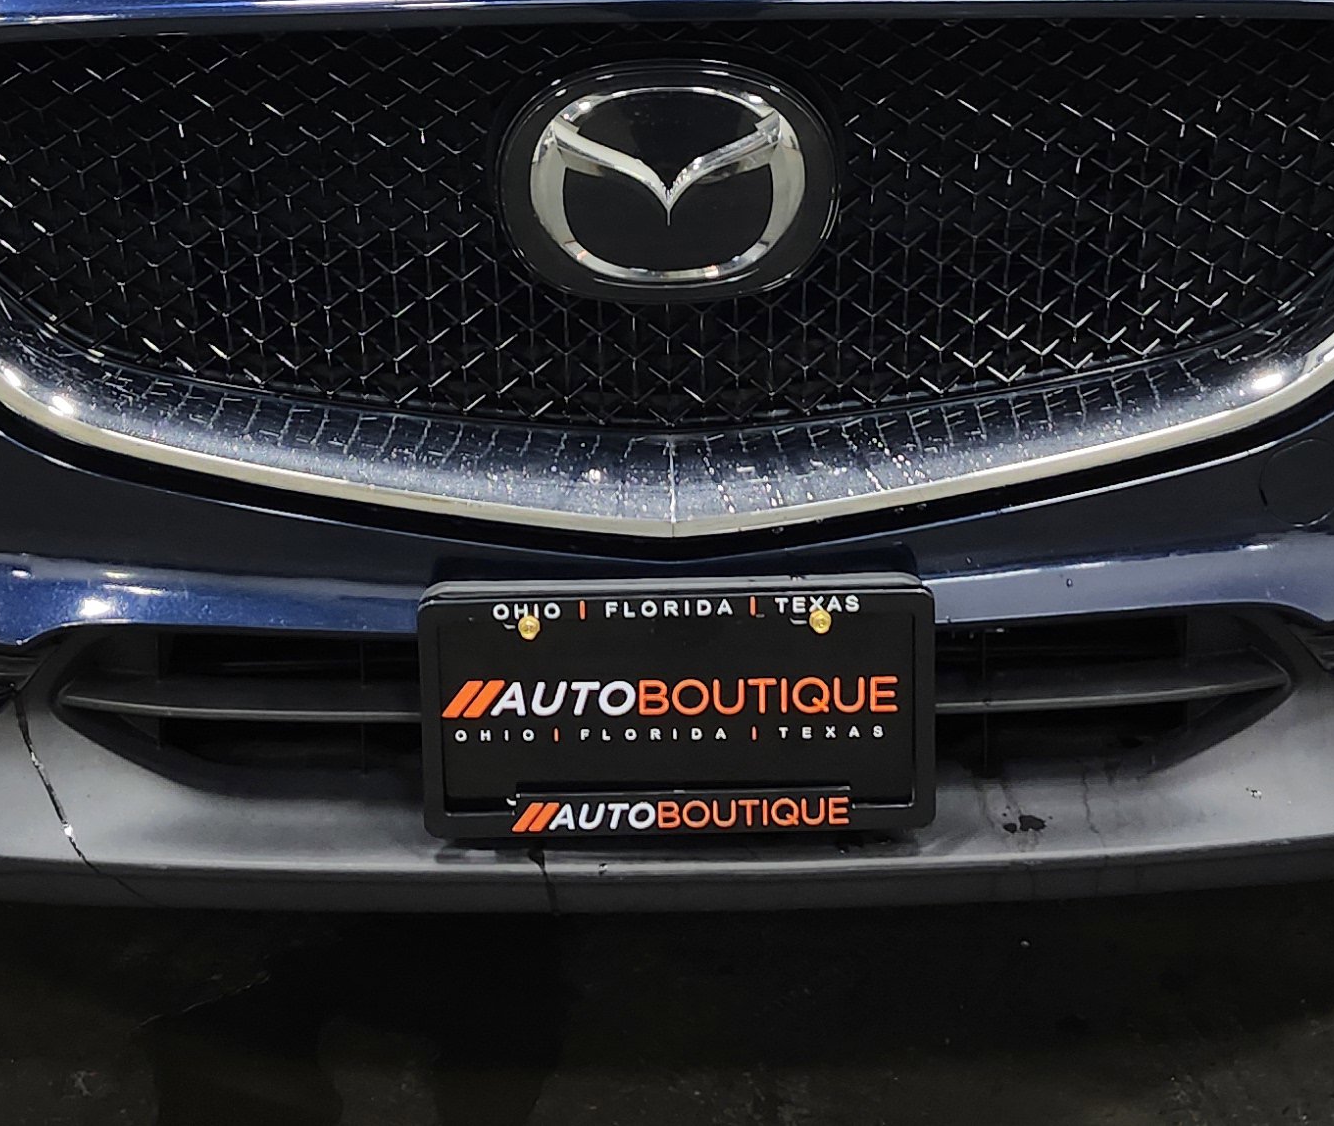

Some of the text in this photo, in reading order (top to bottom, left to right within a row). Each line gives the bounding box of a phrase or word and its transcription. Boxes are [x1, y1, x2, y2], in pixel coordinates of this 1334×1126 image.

[492, 595, 860, 621] OHIO FLORIDA TEXAS
[490, 675, 899, 717] AUTOBOUTIQUE
[454, 725, 885, 742] OHIO FLORIDA TEXAS
[549, 796, 850, 831] AUTOBOUTIQUE
